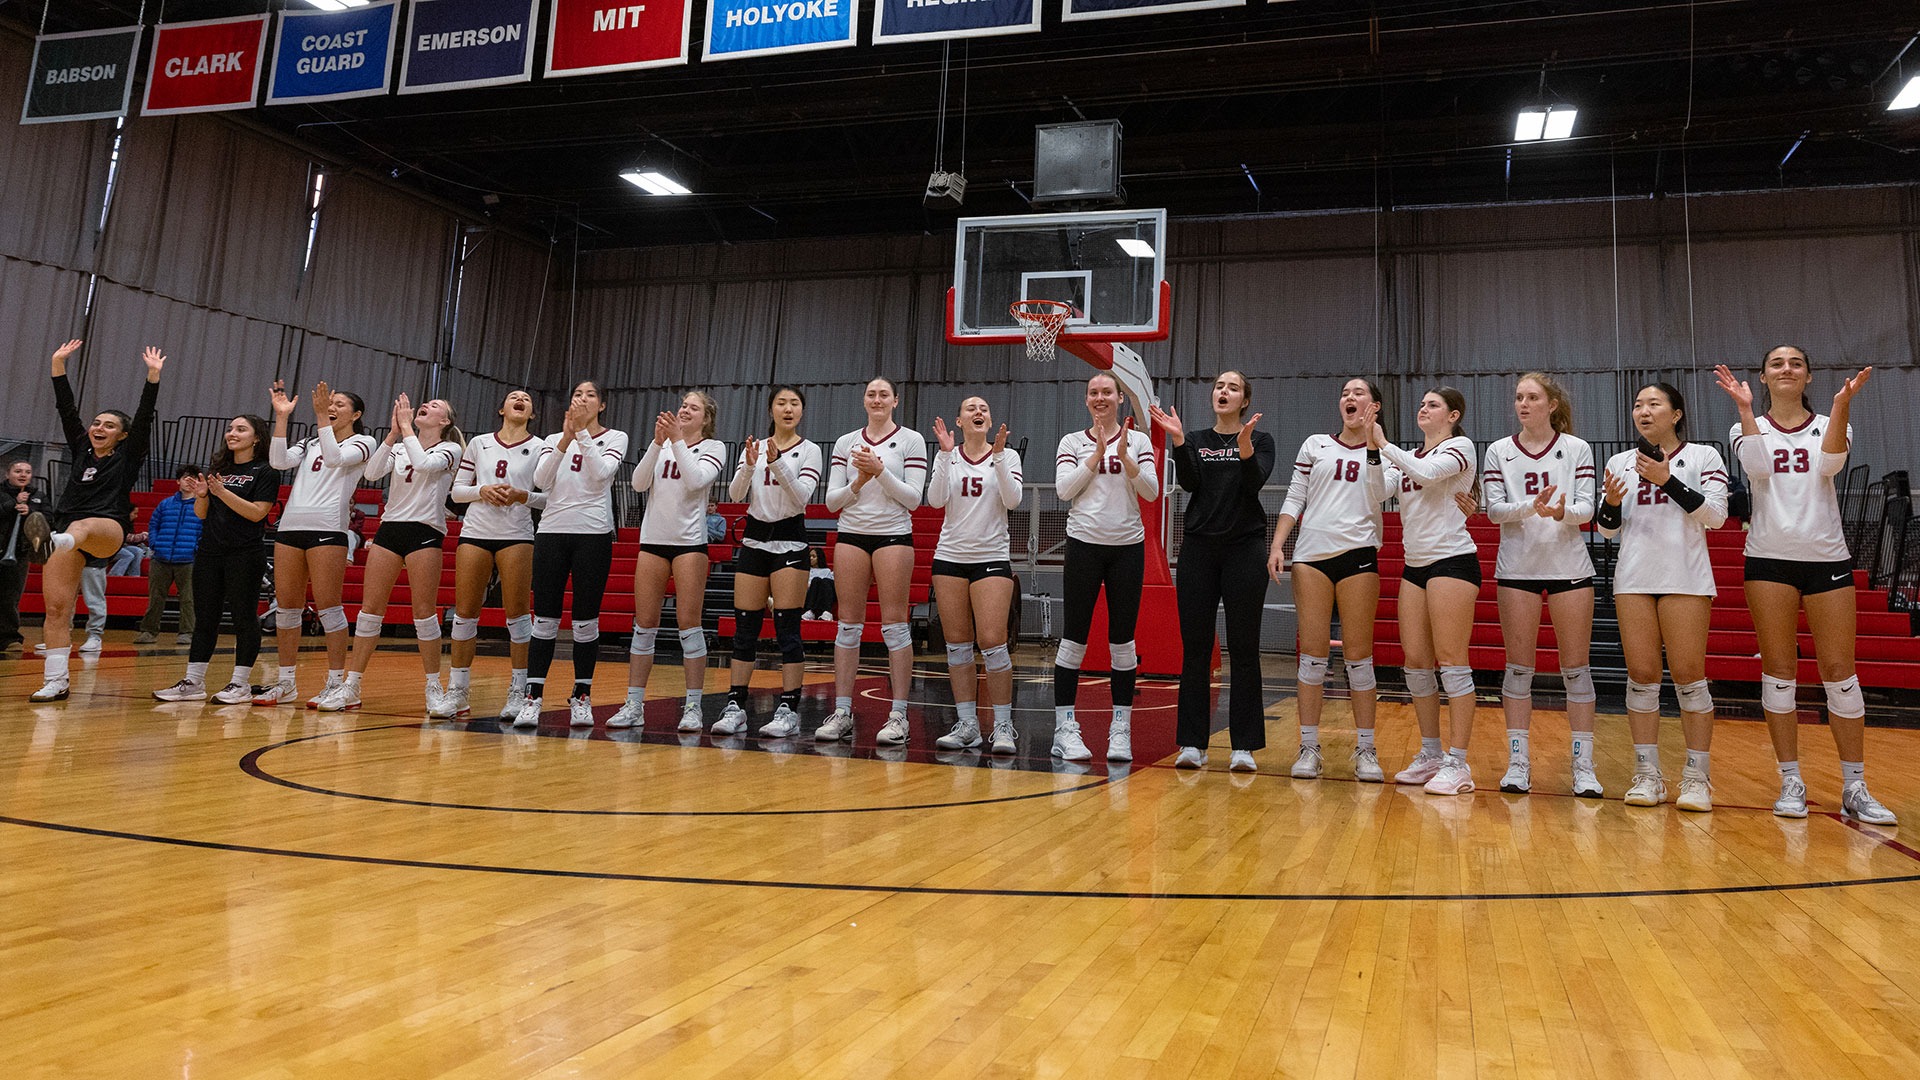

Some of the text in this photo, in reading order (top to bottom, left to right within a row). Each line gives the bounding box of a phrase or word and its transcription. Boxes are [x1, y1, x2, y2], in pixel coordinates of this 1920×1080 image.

[592, 5, 645, 33] MIT
[726, 0, 839, 28] HOLYOKE
[301, 29, 368, 52] COAST
[417, 23, 522, 51] EMERSON
[45, 63, 117, 85] BABSON
[164, 51, 244, 78] CLARK
[296, 52, 366, 75] GUARD
[311, 455, 324, 472] 6
[495, 459, 508, 479] 8
[570, 453, 584, 473] 9
[1098, 455, 1122, 475] 16
[1333, 458, 1361, 483] 18
[1773, 448, 1810, 473] 23
[404, 464, 415, 483] 7
[1524, 471, 1550, 496] 21
[961, 476, 984, 497] 15
